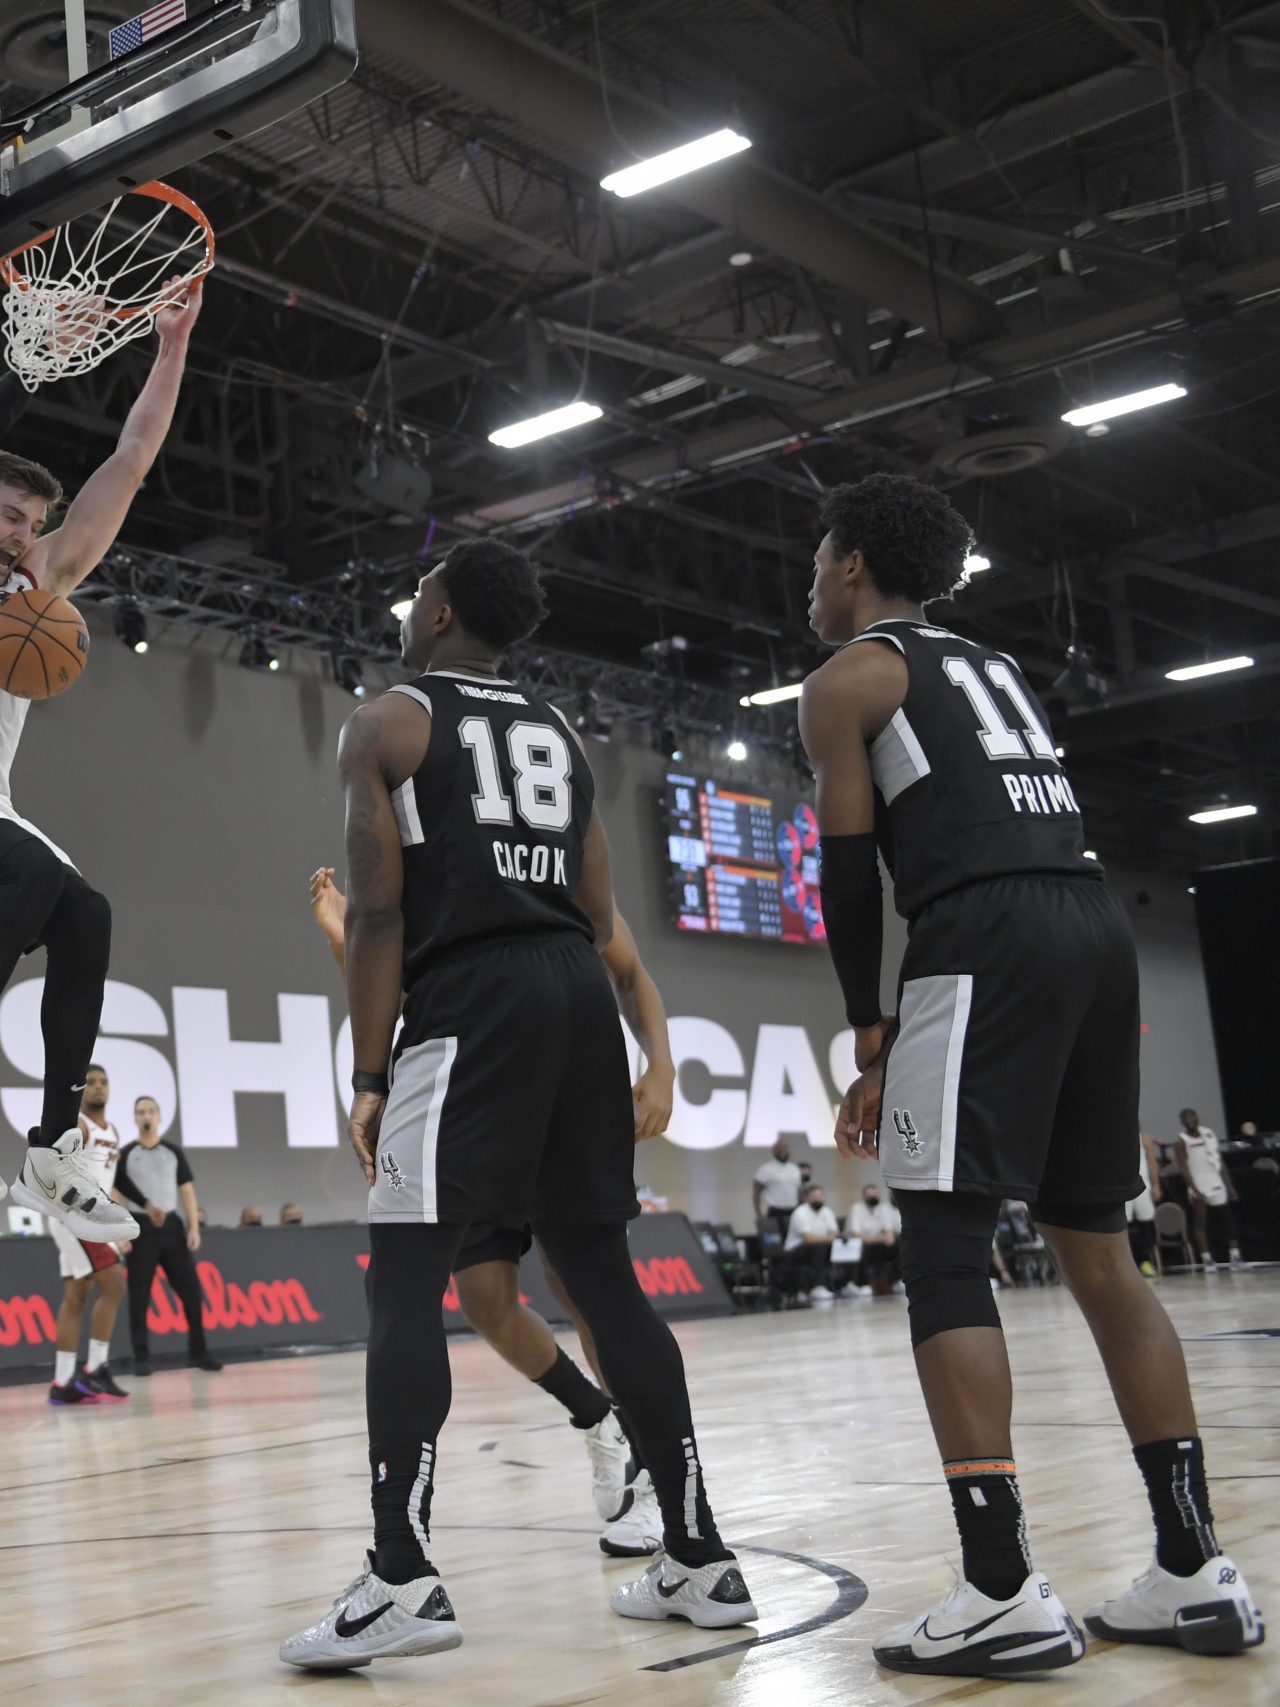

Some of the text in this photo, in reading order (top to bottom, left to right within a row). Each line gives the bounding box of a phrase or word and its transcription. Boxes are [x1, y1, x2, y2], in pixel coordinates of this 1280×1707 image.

[942, 657, 1061, 767] 11
[457, 716, 572, 833] 18
[493, 841, 567, 886] CACOK
[124, 1261, 322, 1335] lson
